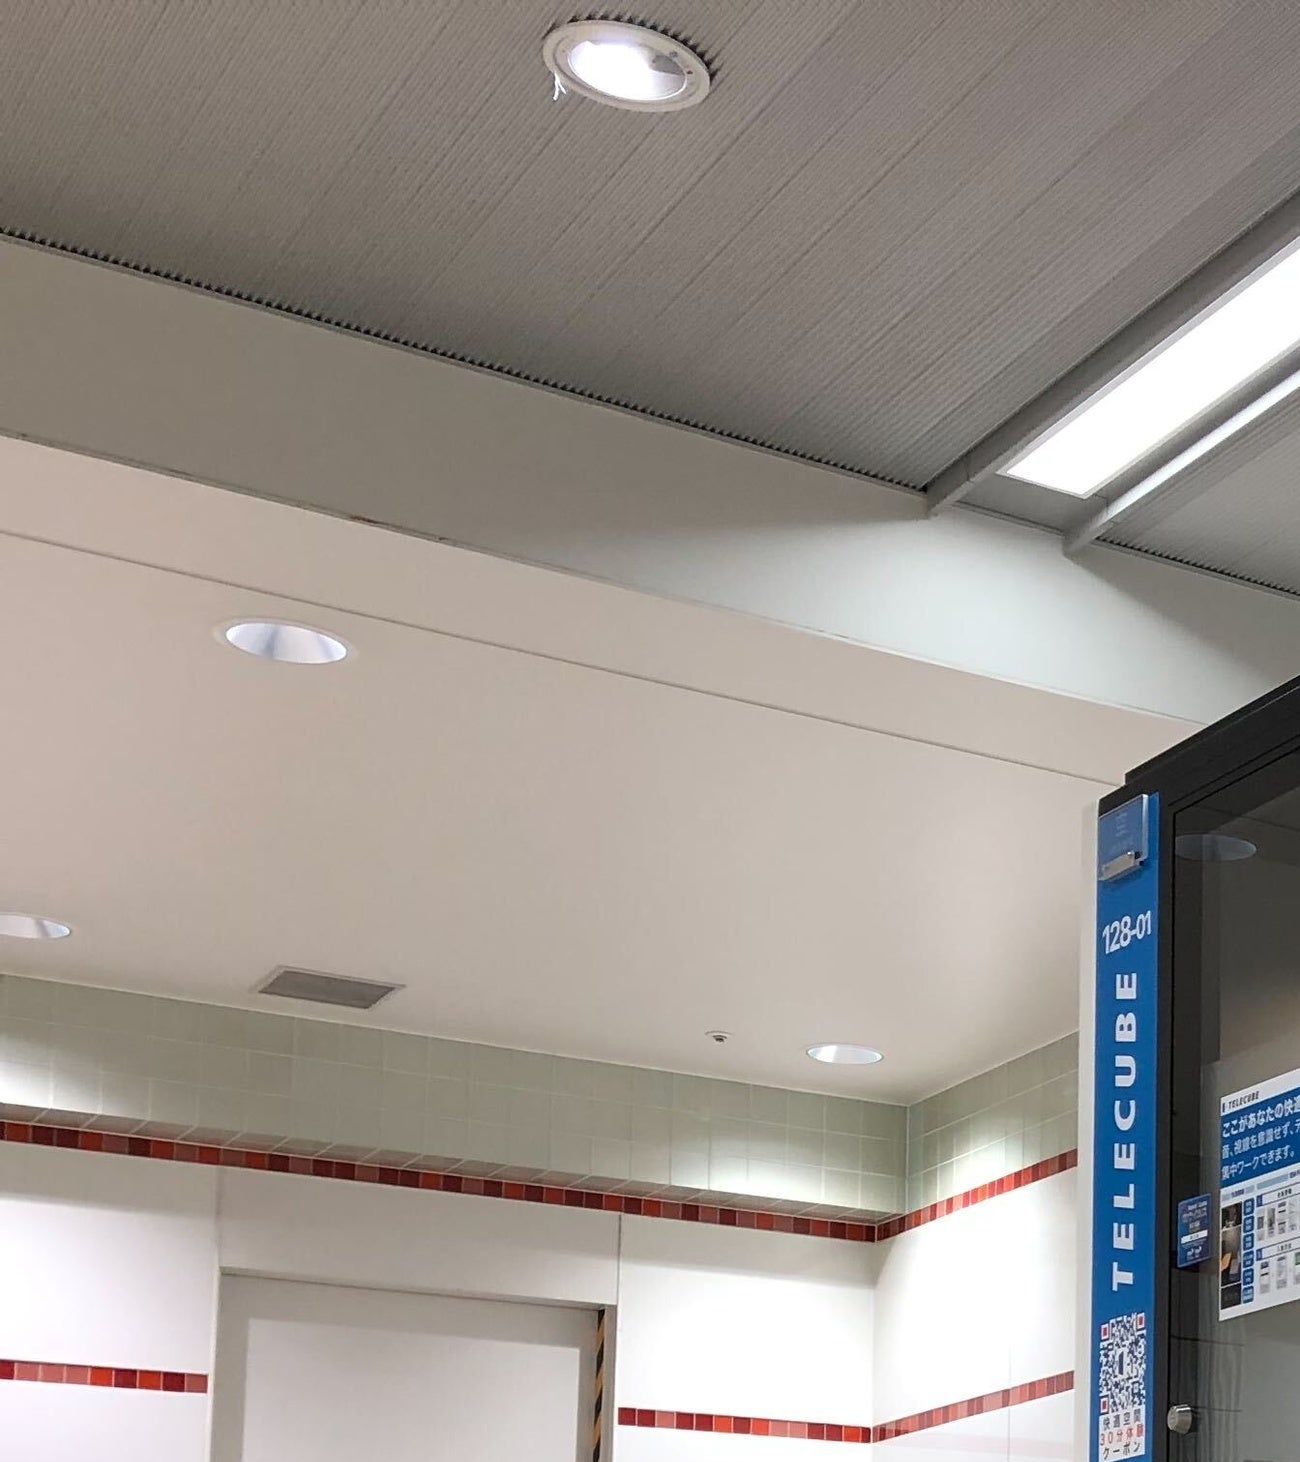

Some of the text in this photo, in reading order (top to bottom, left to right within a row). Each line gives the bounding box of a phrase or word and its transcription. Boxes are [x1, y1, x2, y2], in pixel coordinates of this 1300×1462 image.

[1102, 910, 1152, 954] 128-01
[1228, 1091, 1260, 1110] TELECUBE
[1112, 972, 1138, 1292] TELECUBE
[1102, 1441, 1141, 1460] クーポン
